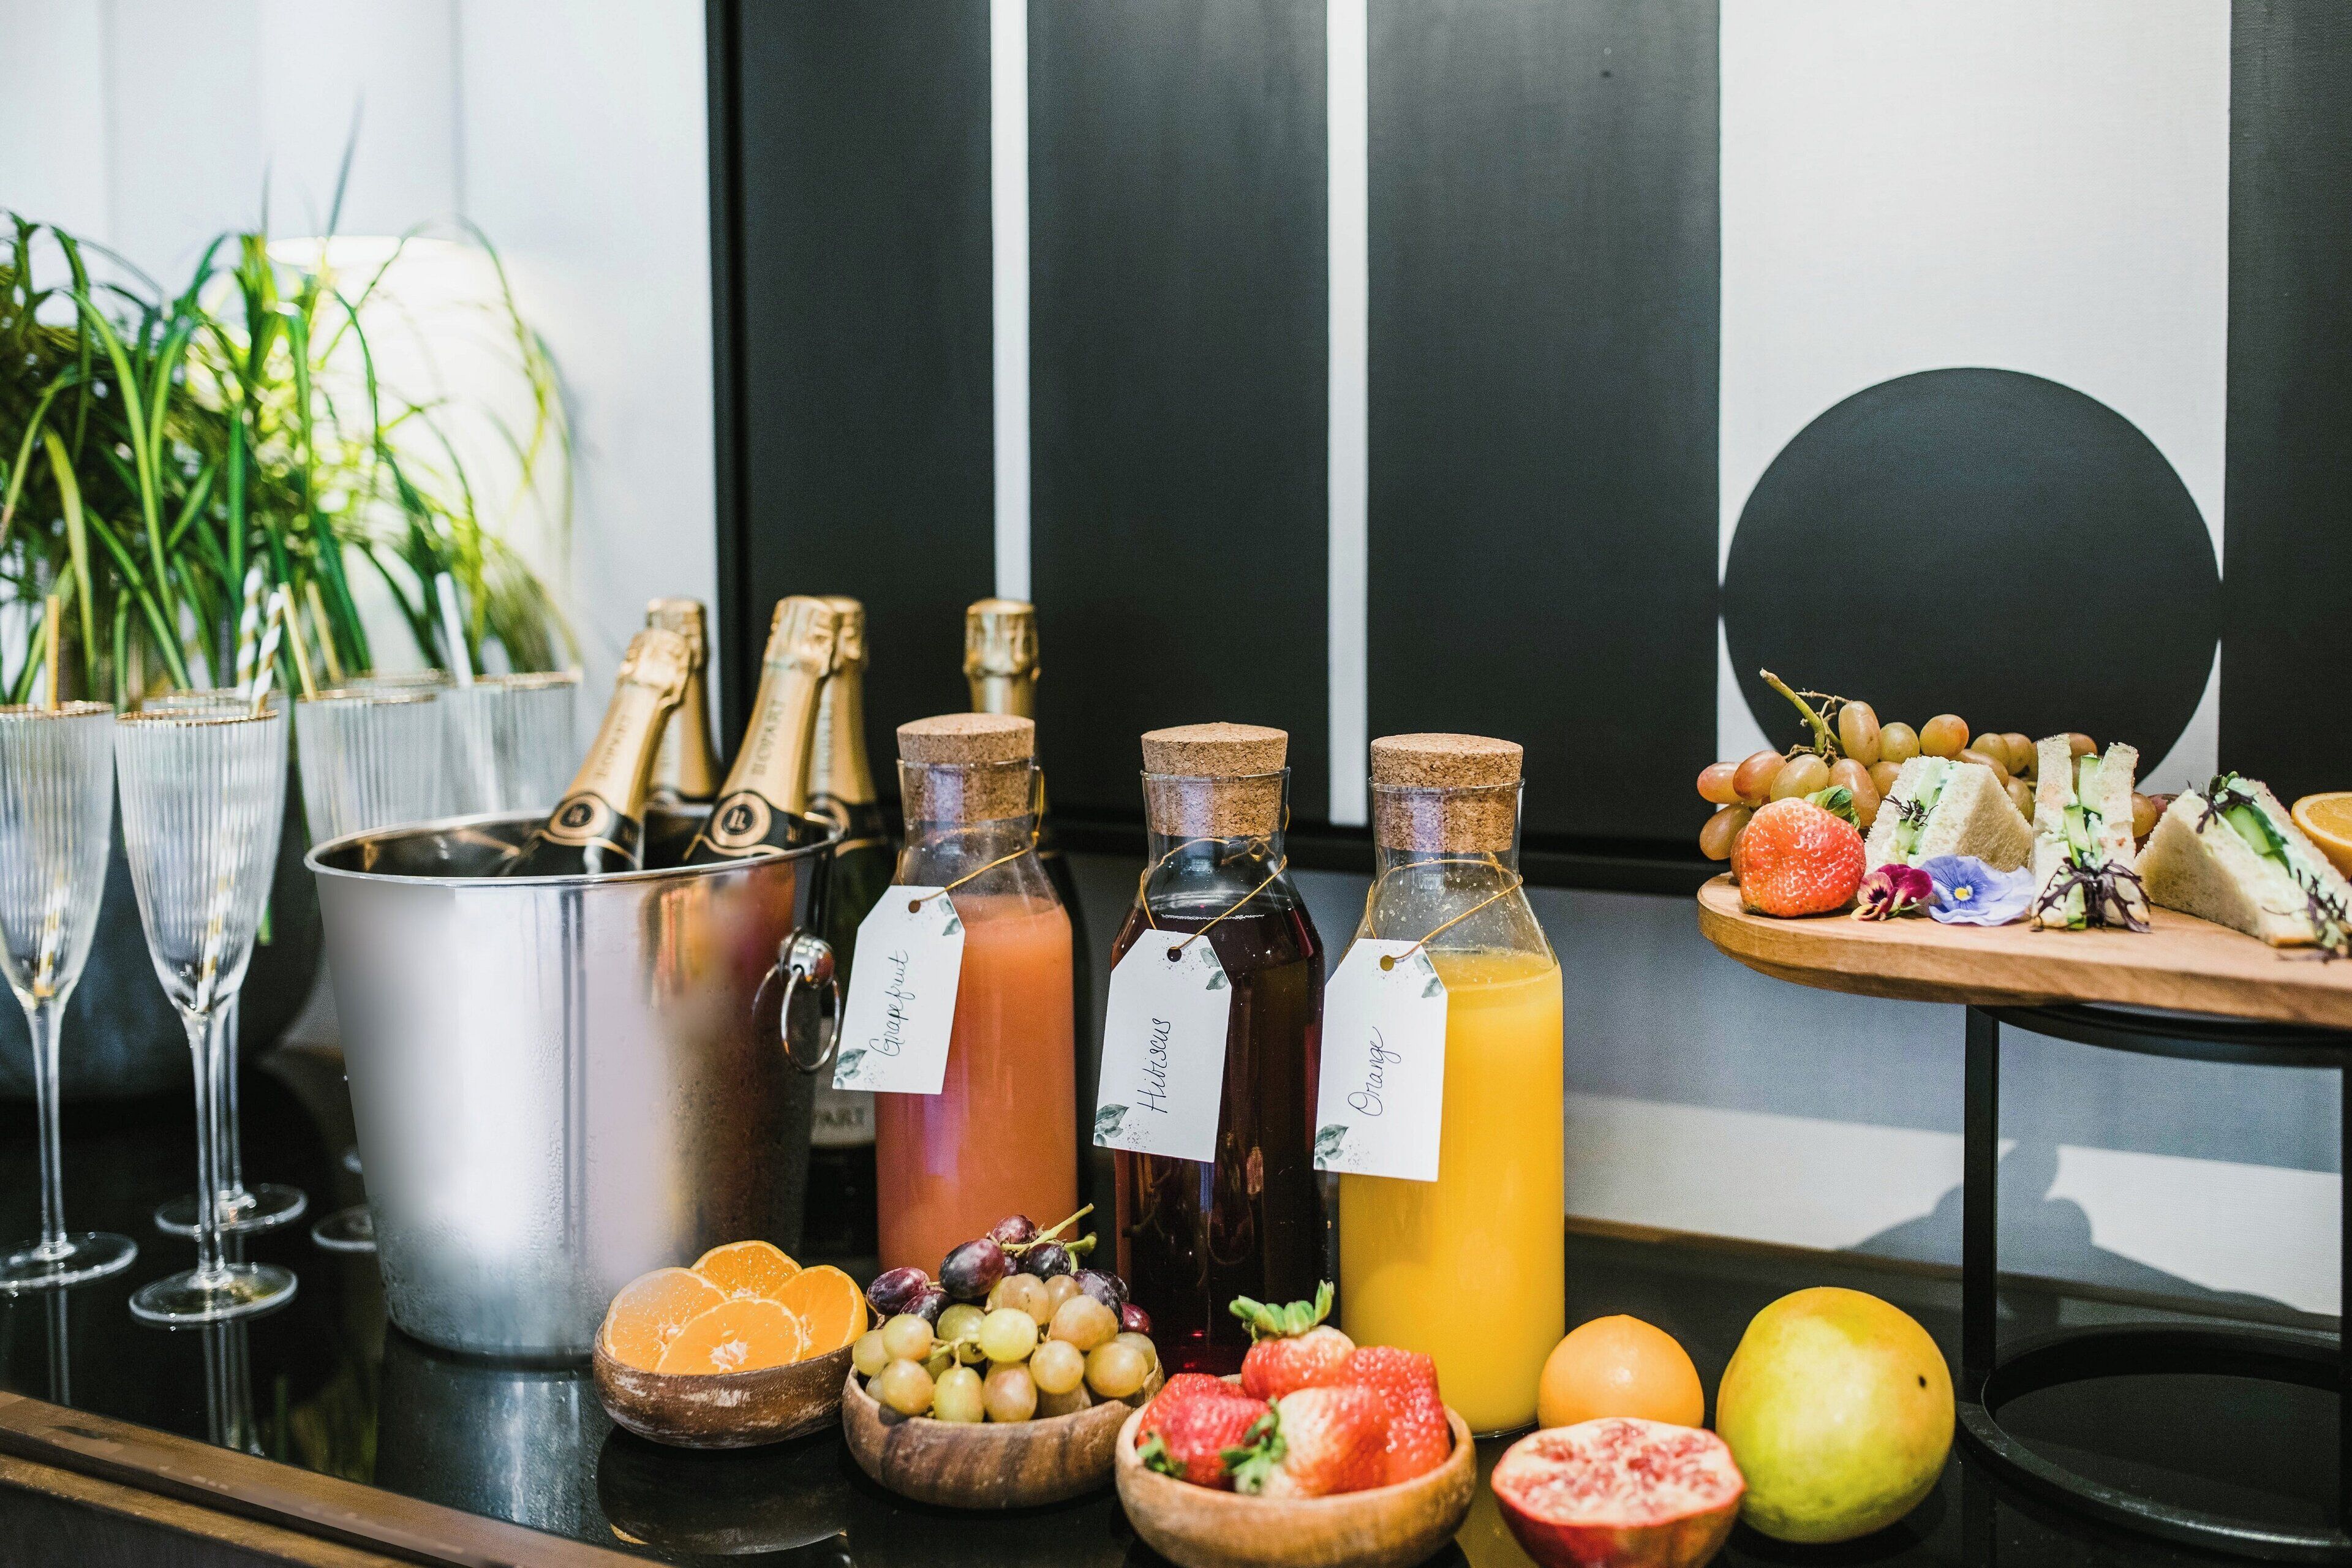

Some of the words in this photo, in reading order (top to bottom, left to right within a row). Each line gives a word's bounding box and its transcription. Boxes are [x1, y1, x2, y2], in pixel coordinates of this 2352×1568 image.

[869, 949, 915, 1057] Grapefruit
[1136, 1017, 1171, 1114] Hibiscus
[1347, 1026, 1401, 1117] Orange
